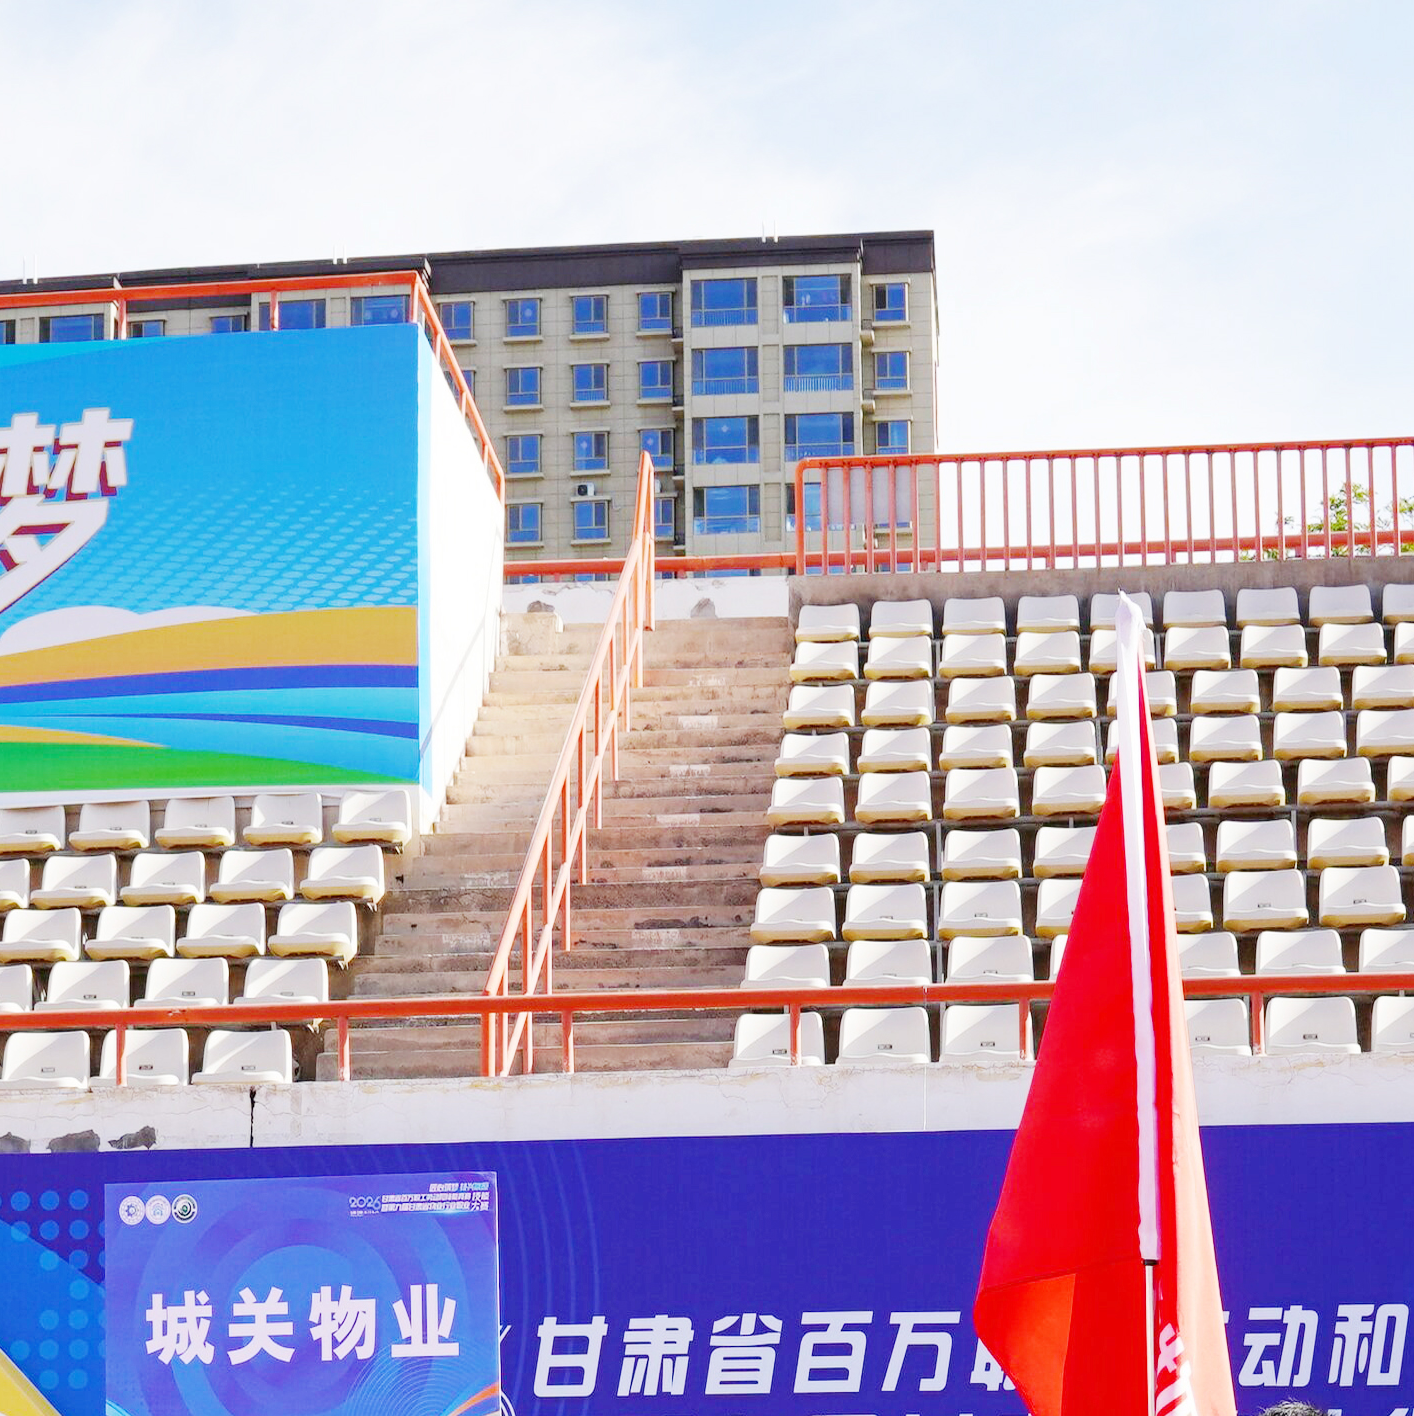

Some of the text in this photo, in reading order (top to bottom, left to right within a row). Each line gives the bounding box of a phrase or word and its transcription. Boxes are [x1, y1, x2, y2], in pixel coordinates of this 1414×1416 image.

[348, 1195, 382, 1211] 2026
[145, 1283, 461, 1366] 城关物业
[532, 1309, 1017, 1398] 甘肃省百万
